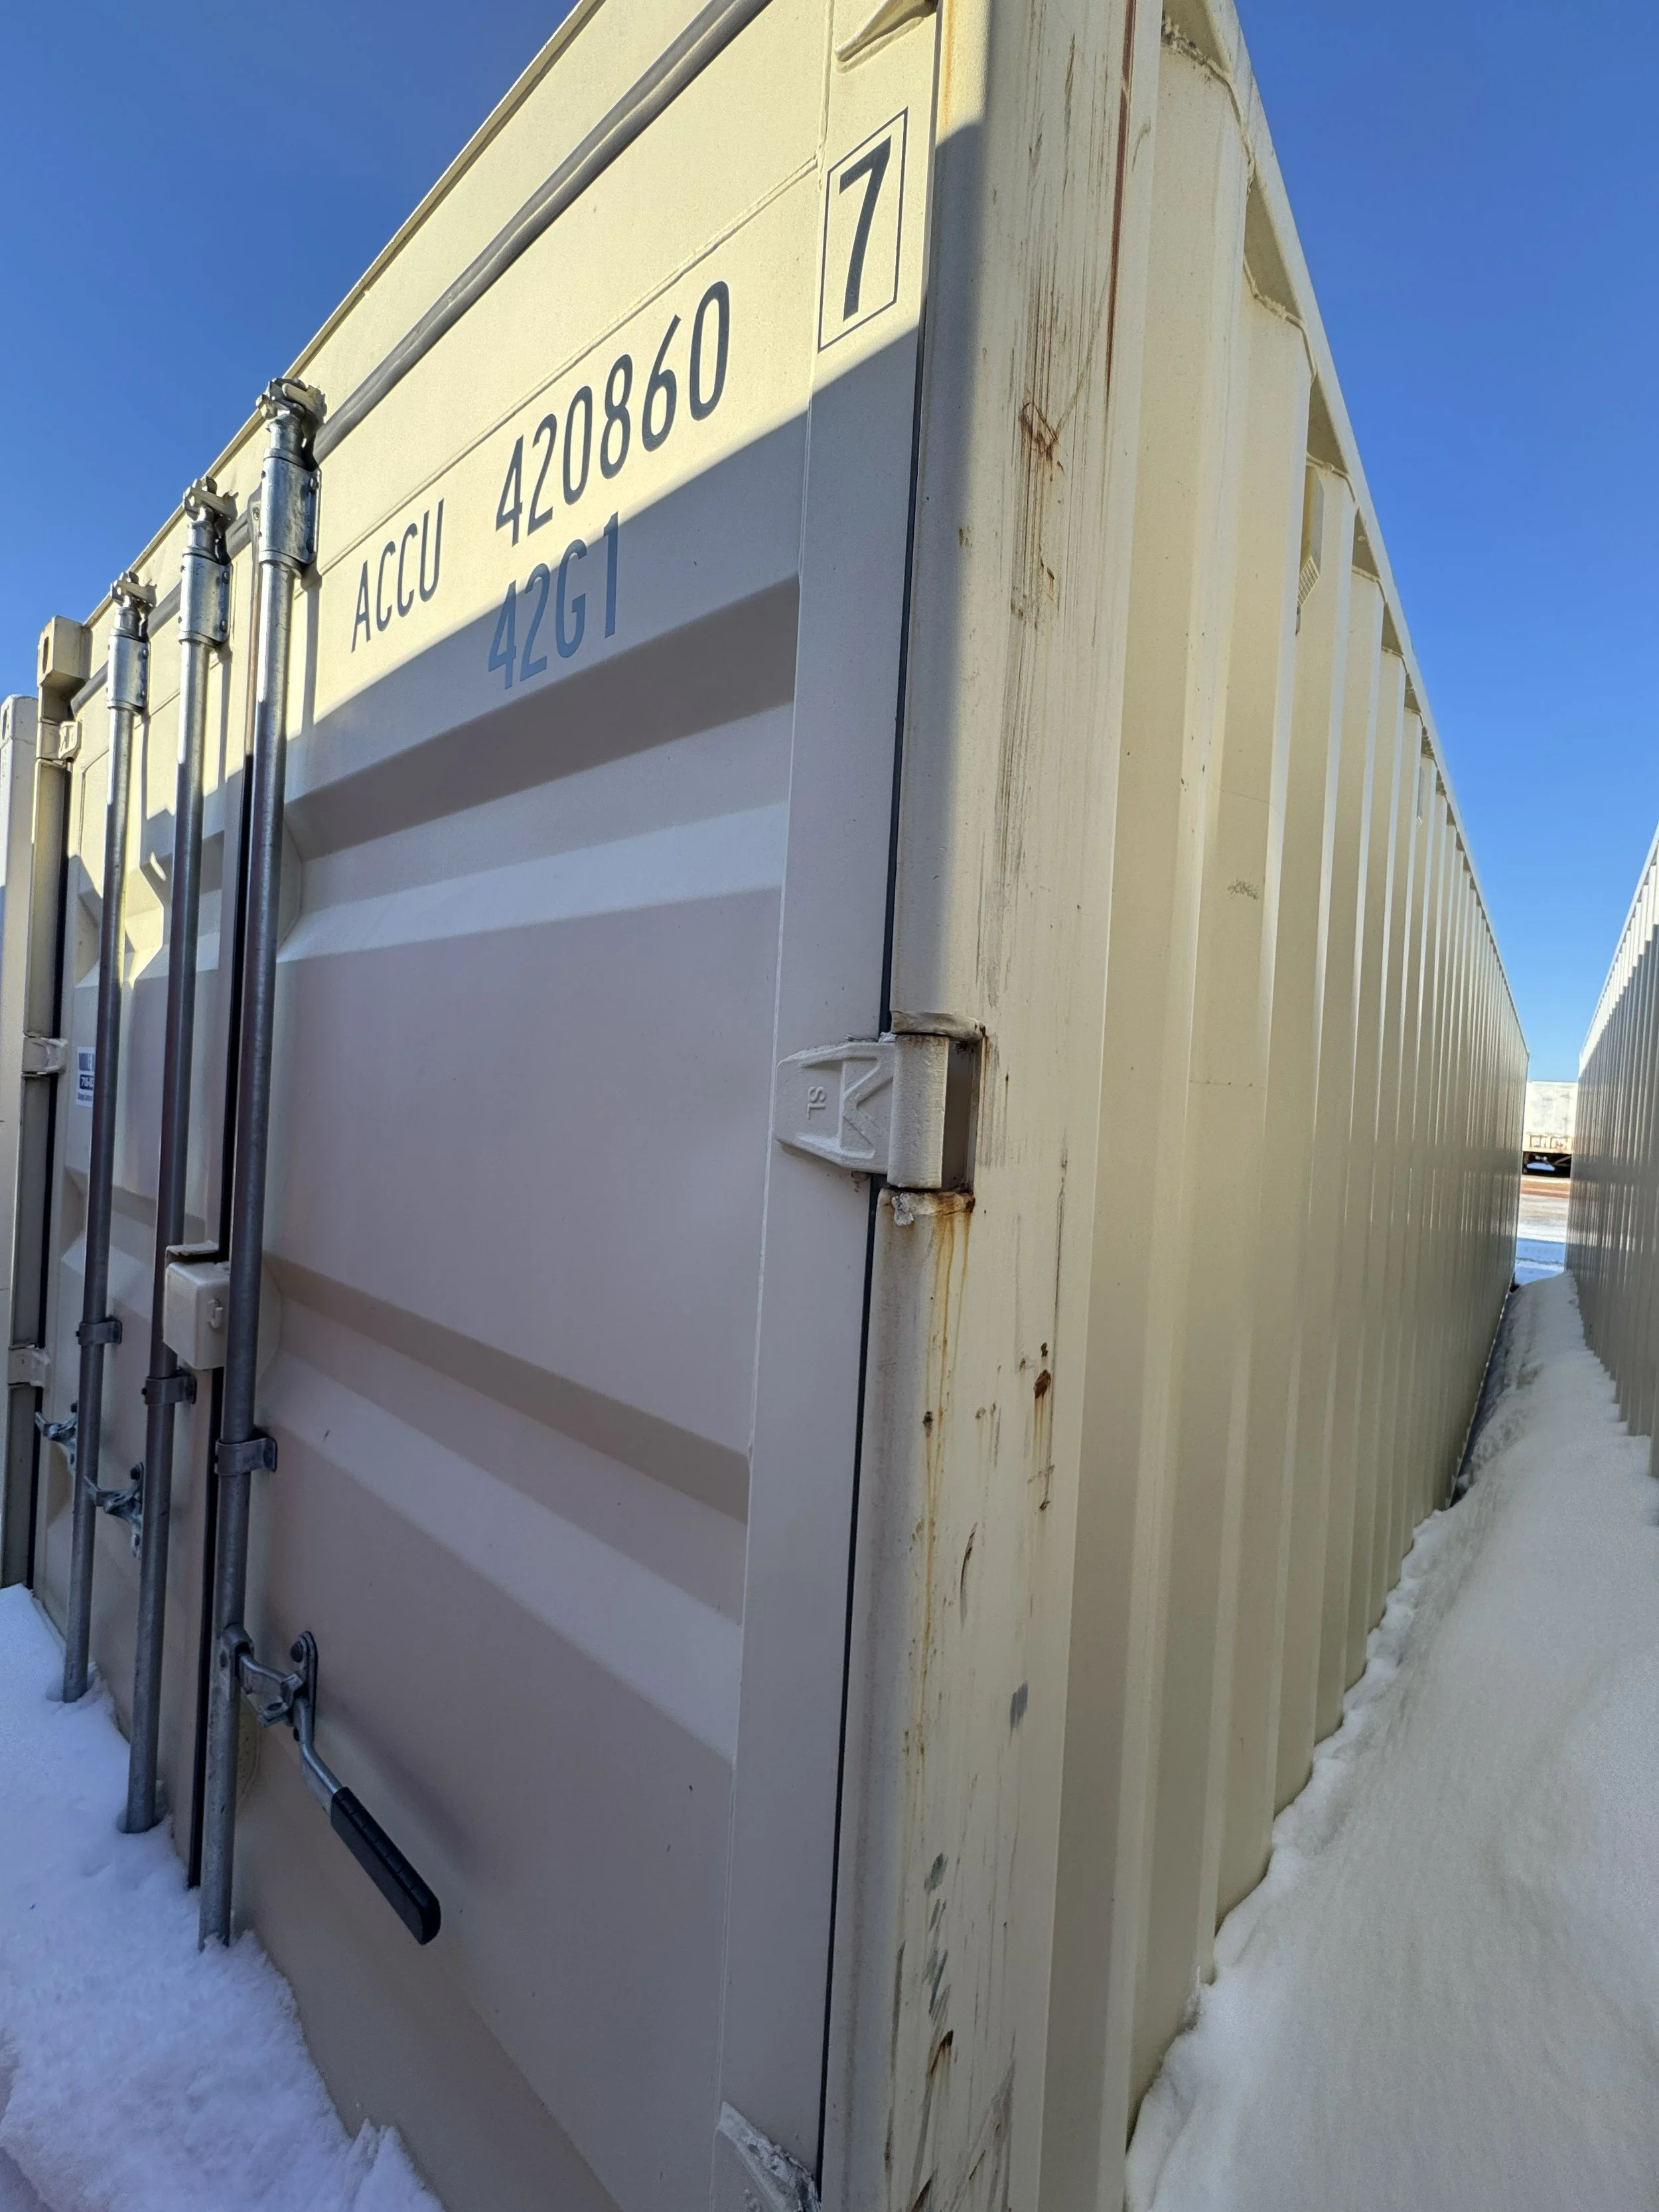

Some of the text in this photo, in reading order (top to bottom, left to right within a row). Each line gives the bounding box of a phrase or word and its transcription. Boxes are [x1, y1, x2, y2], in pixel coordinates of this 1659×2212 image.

[351, 135, 892, 653] ACCU 420860 7
[488, 510, 620, 689] 42G1
